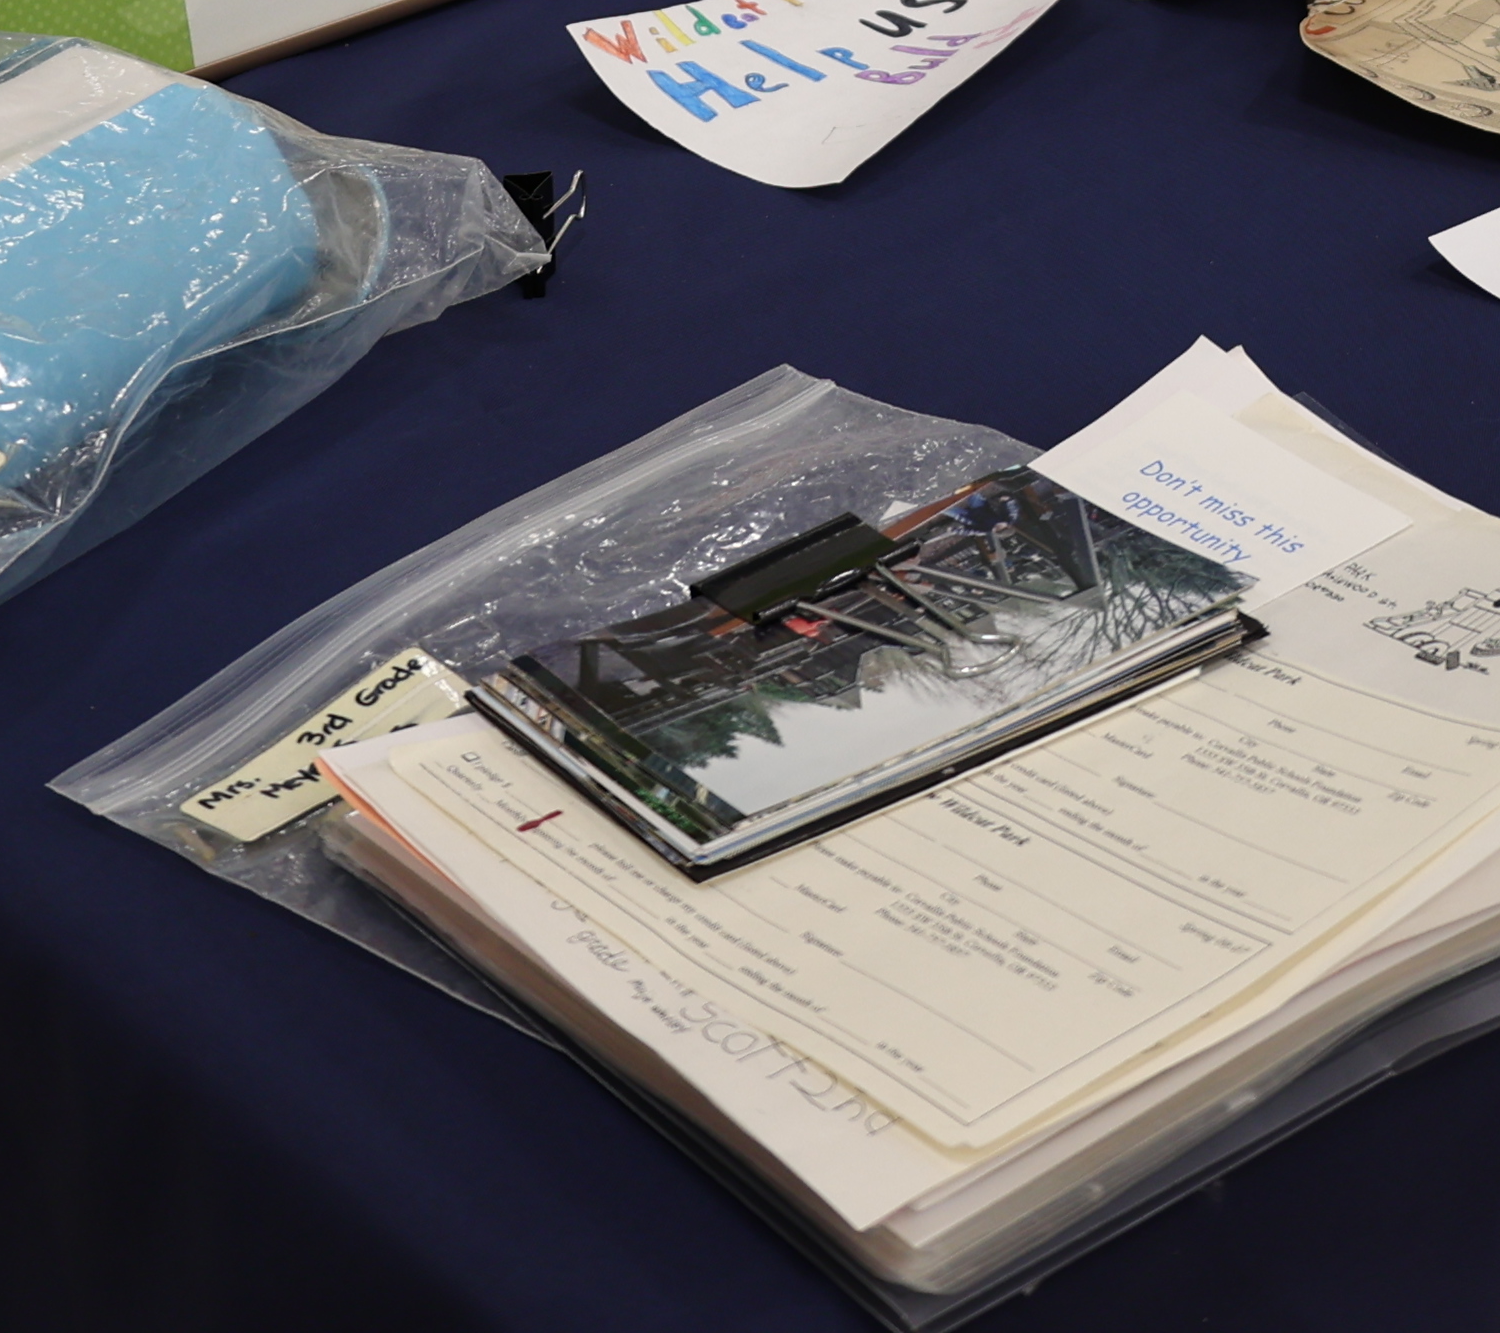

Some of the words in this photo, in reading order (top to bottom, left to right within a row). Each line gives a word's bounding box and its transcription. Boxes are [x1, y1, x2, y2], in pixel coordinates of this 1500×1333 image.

[646, 40, 869, 123] Help
[1121, 489, 1252, 567] opportunity
[1139, 458, 1203, 499] Don't
[1201, 485, 1255, 530] miss
[1256, 517, 1306, 556] this
[1263, 660, 1301, 687] Park
[198, 775, 264, 812] Mrs.
[297, 713, 353, 748] 3rd
[355, 655, 424, 709] Grade
[1102, 732, 1154, 760] MasterCard
[941, 794, 995, 830] Wildcat
[998, 823, 1031, 847] Park
